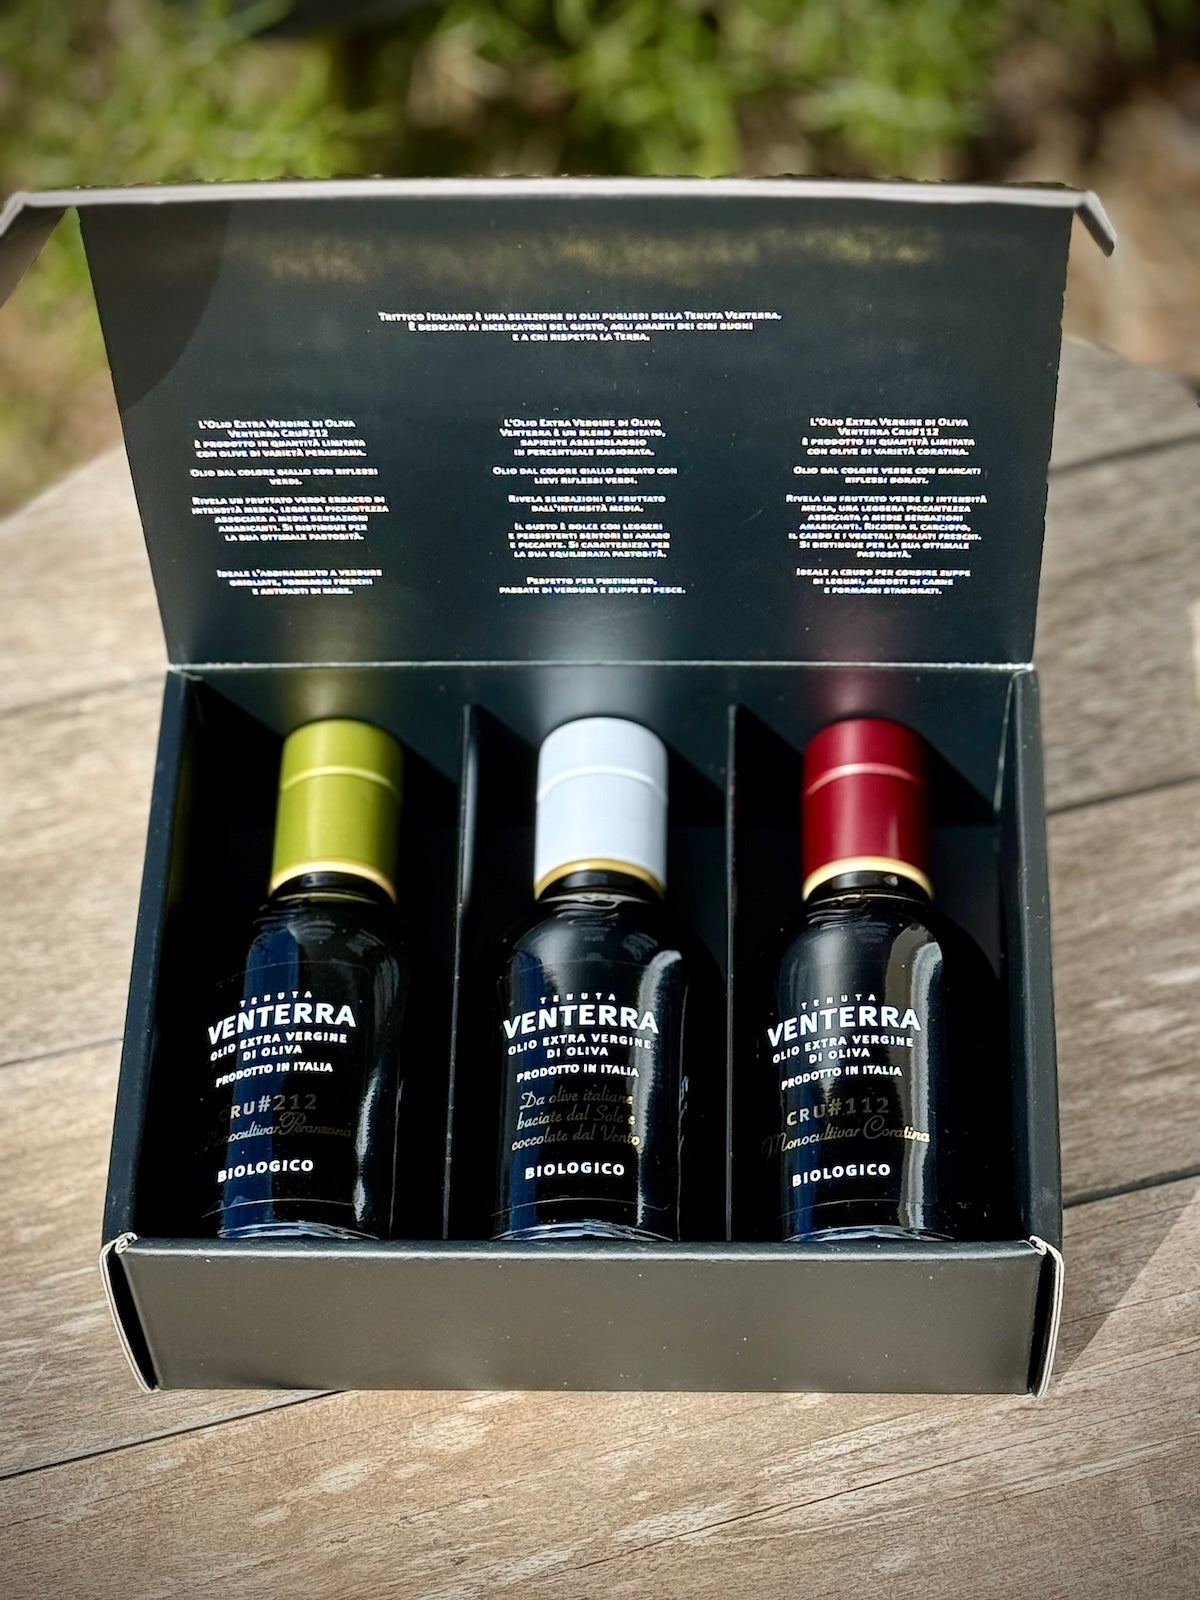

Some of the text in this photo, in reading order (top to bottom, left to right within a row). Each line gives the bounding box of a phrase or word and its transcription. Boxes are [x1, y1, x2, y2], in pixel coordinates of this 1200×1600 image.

[240, 991, 312, 1007] TENUTA
[540, 993, 615, 1004] TENUTA
[801, 994, 876, 1010] TENUTA
[208, 1003, 356, 1045] VENTERRA
[503, 1004, 659, 1039] VENTERRA
[767, 1006, 921, 1047] VENTERRA
[210, 1032, 347, 1061] OLIO EXTRA VERGINE
[243, 1044, 302, 1061] DI OLIVA
[508, 1034, 652, 1056] OLIO EXTRA VERGINE
[547, 1046, 608, 1058] DI OLIVA
[772, 1035, 914, 1064] OLIO EXTRA VERGINE
[808, 1048, 870, 1064] DI OLIVA
[216, 1062, 333, 1088] PRODOTTO IN ITALIA
[516, 1064, 640, 1083] PRODOTTO IN ITALIA
[781, 1065, 902, 1090] PRODOTTO IN ITALIA
[519, 1091, 545, 1110] Da
[786, 1097, 889, 1126] CRU#112
[600, 1124, 640, 1146] Vento
[217, 1160, 314, 1183] BIOLOGICO
[524, 1162, 624, 1180] BIOLOGICO
[792, 1164, 890, 1187] BIOLOGICO
